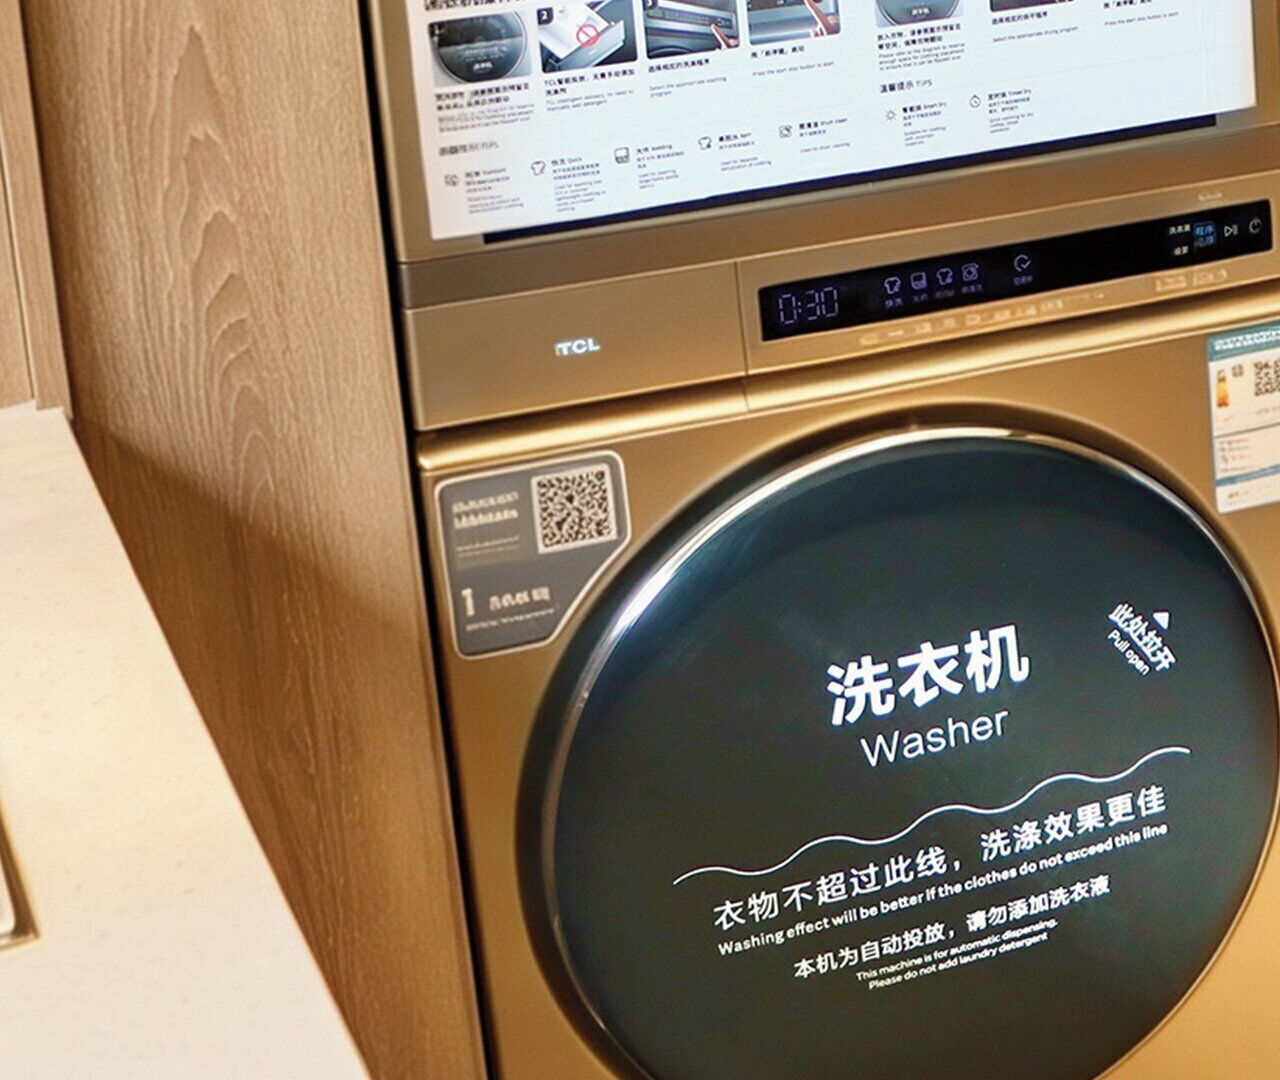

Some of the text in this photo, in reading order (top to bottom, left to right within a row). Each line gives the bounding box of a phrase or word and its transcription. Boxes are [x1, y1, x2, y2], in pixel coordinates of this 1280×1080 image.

[778, 287, 838, 325] 0:30
[556, 337, 601, 355] TCL
[462, 588, 475, 617] 1
[1107, 629, 1151, 676] Pull open
[1108, 603, 1176, 673] 此处拉开
[825, 624, 1030, 726] 洗衣机
[861, 708, 1009, 767] Washer
[713, 785, 1167, 931] 衣物不超过此线，洗涤效果更佳
[718, 823, 1168, 956] Washing effect will be better if the clothes do not exceed this line
[794, 874, 1111, 980] 本机为自动投放，请勿添加洗衣液
[856, 969, 878, 981] This
[878, 956, 923, 976] machine
[933, 948, 949, 960] for
[949, 934, 1001, 956] automatic
[1001, 919, 1058, 942] dispensing.
[868, 974, 903, 991] Please
[919, 963, 937, 976] not
[937, 956, 959, 971] add
[958, 946, 998, 965] laundry
[998, 931, 1048, 954] detergent
